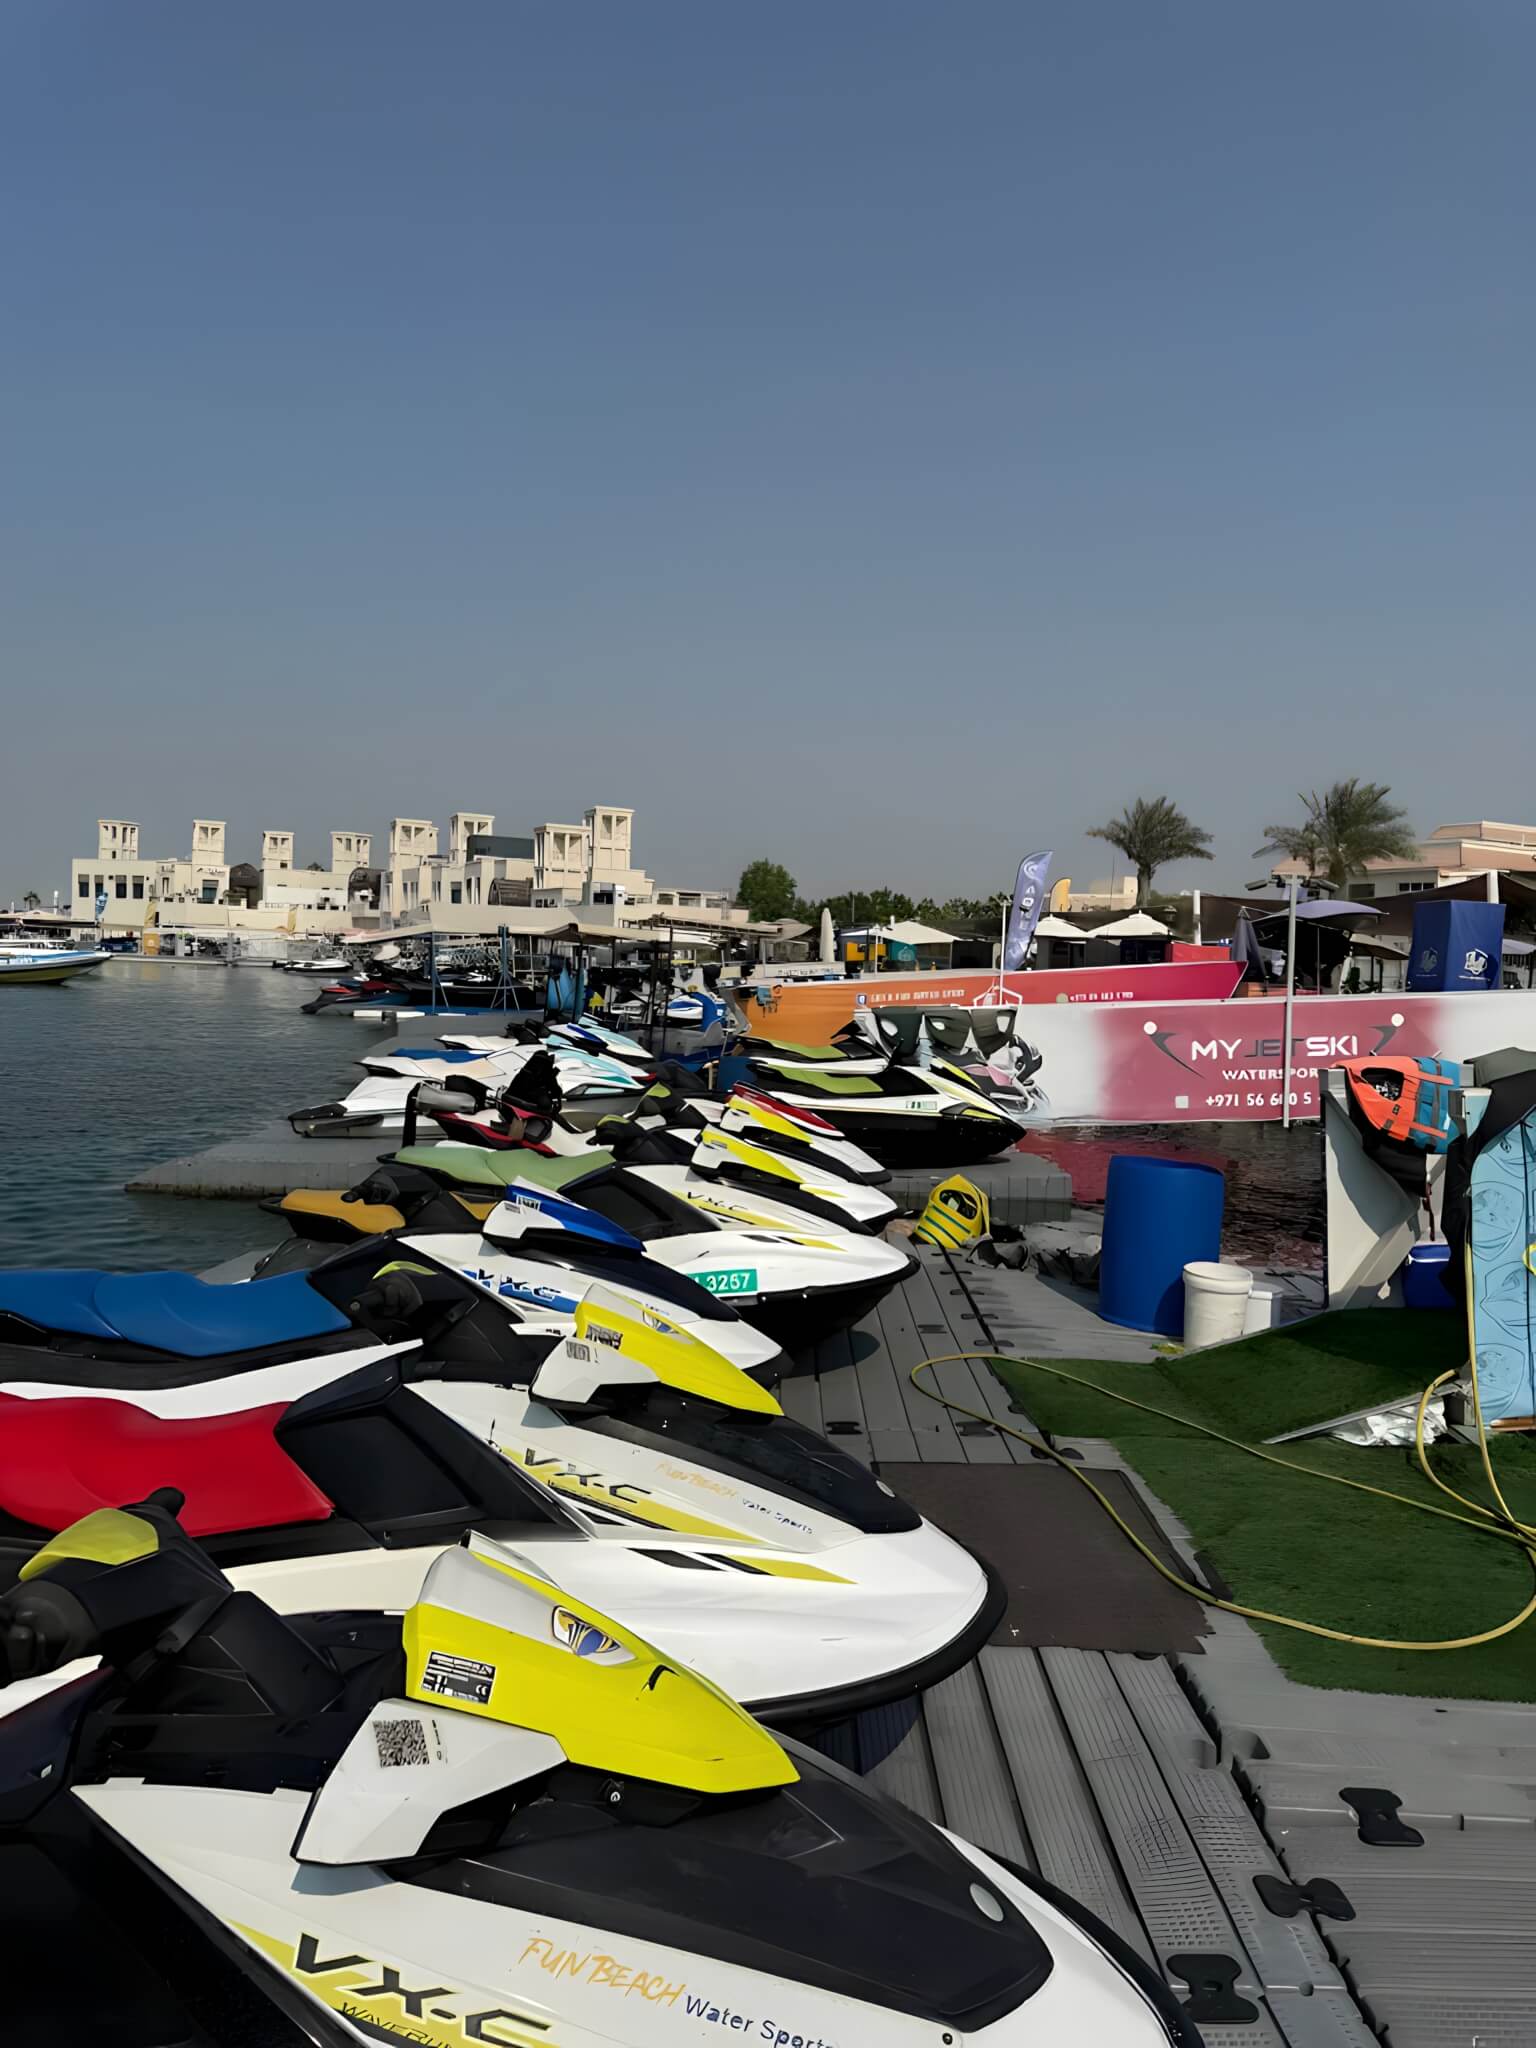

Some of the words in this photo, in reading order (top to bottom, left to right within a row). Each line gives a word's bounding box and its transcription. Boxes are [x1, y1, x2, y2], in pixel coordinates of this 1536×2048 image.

[1206, 1093, 1239, 1107] +971
[1246, 1093, 1265, 1107] 56
[706, 1273, 751, 1292] 3267
[295, 1932, 552, 2048] VX-C
[685, 1994, 754, 2033] Water
[760, 2019, 834, 2048] Sport
